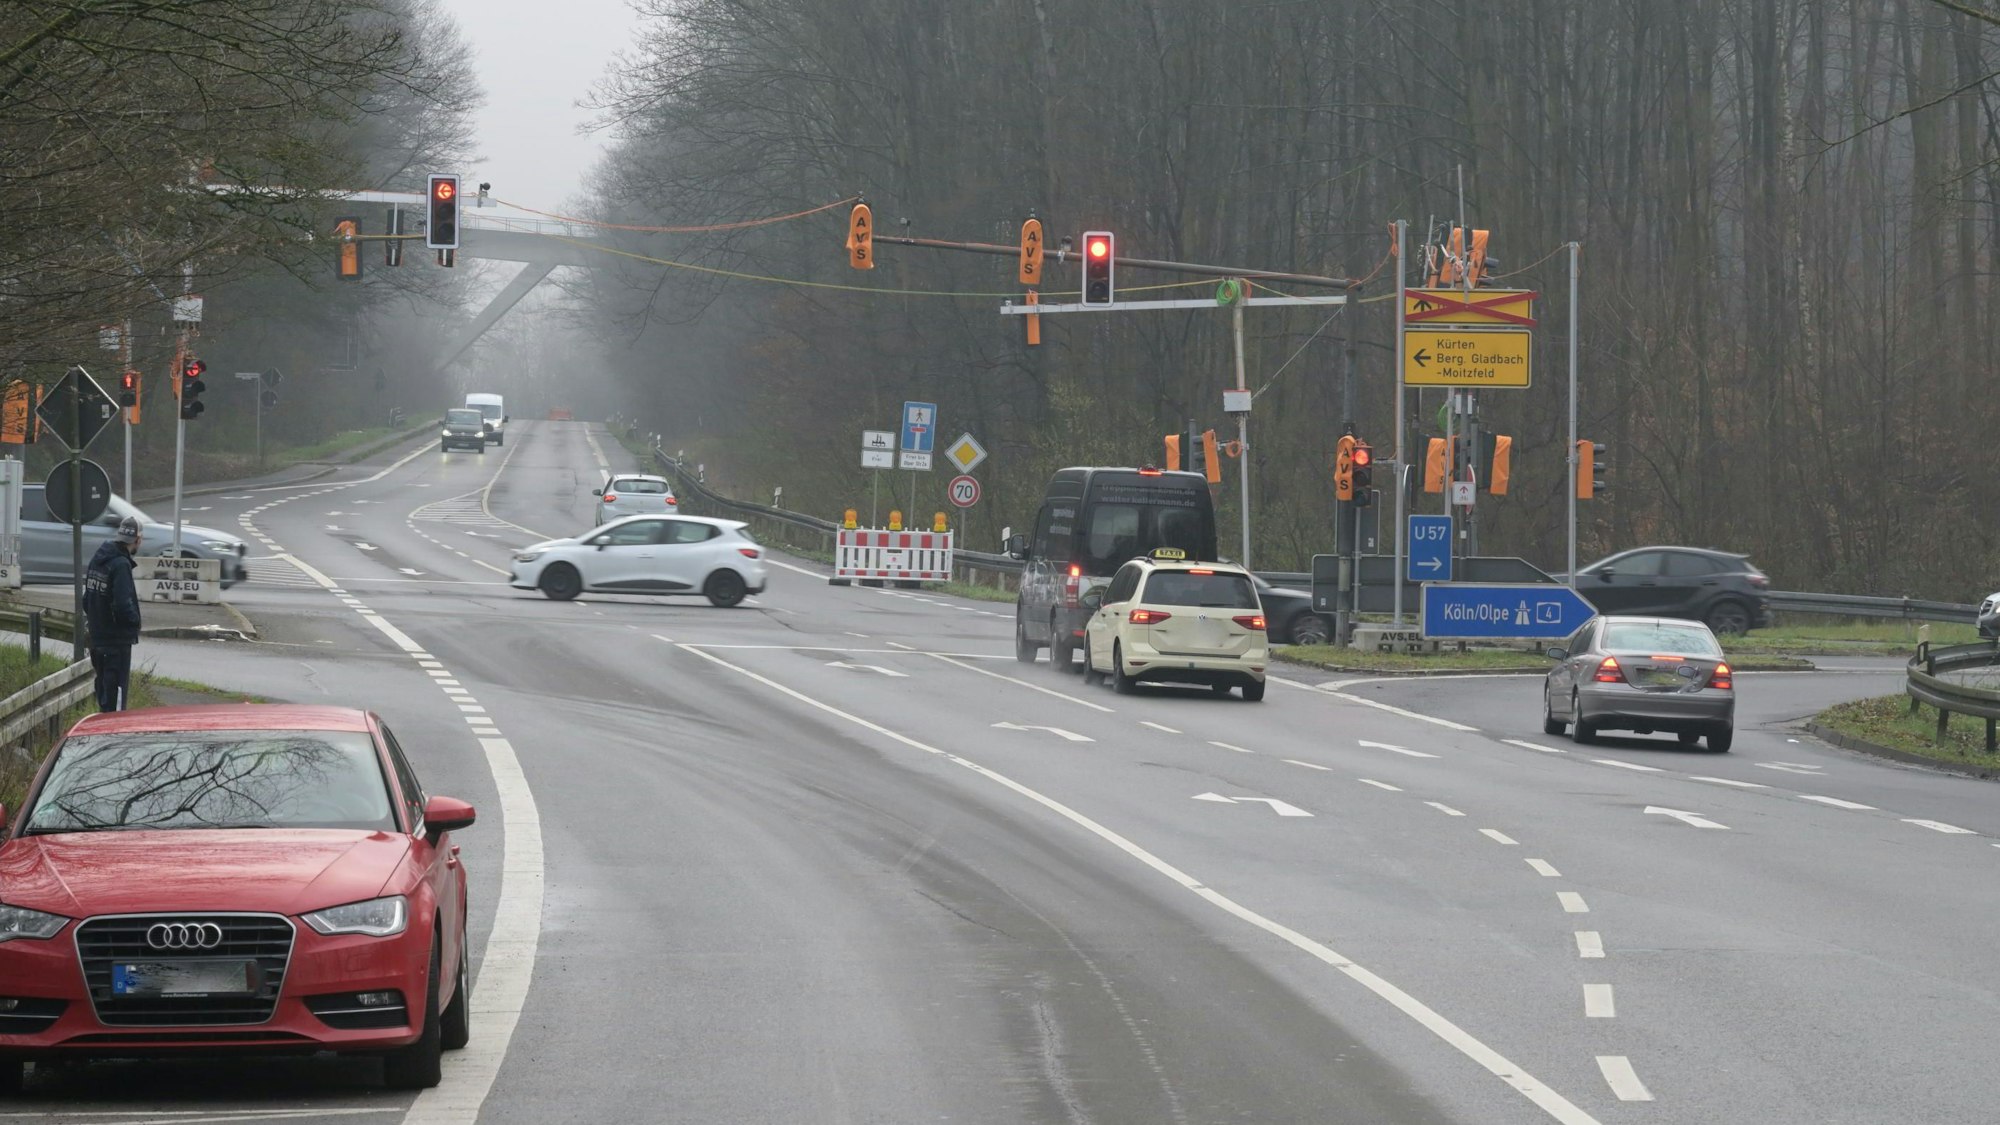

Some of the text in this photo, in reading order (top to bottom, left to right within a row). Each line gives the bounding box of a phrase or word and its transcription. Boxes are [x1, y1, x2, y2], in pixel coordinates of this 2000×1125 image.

[856, 217, 866, 260] AVS
[1024, 231, 1037, 275] AVS
[1437, 339, 1475, 349] Kürten
[1436, 353, 1524, 366] Berg. Gladbach
[1436, 368, 1495, 378] -Moitzfeld
[1340, 448, 1349, 490] AVS
[957, 485, 973, 499] 70
[1415, 526, 1446, 540] U 57
[157, 559, 200, 569] AVS.EU
[156, 581, 200, 591] AVS.EU
[1444, 602, 1552, 624] Köln/Olpe 4
